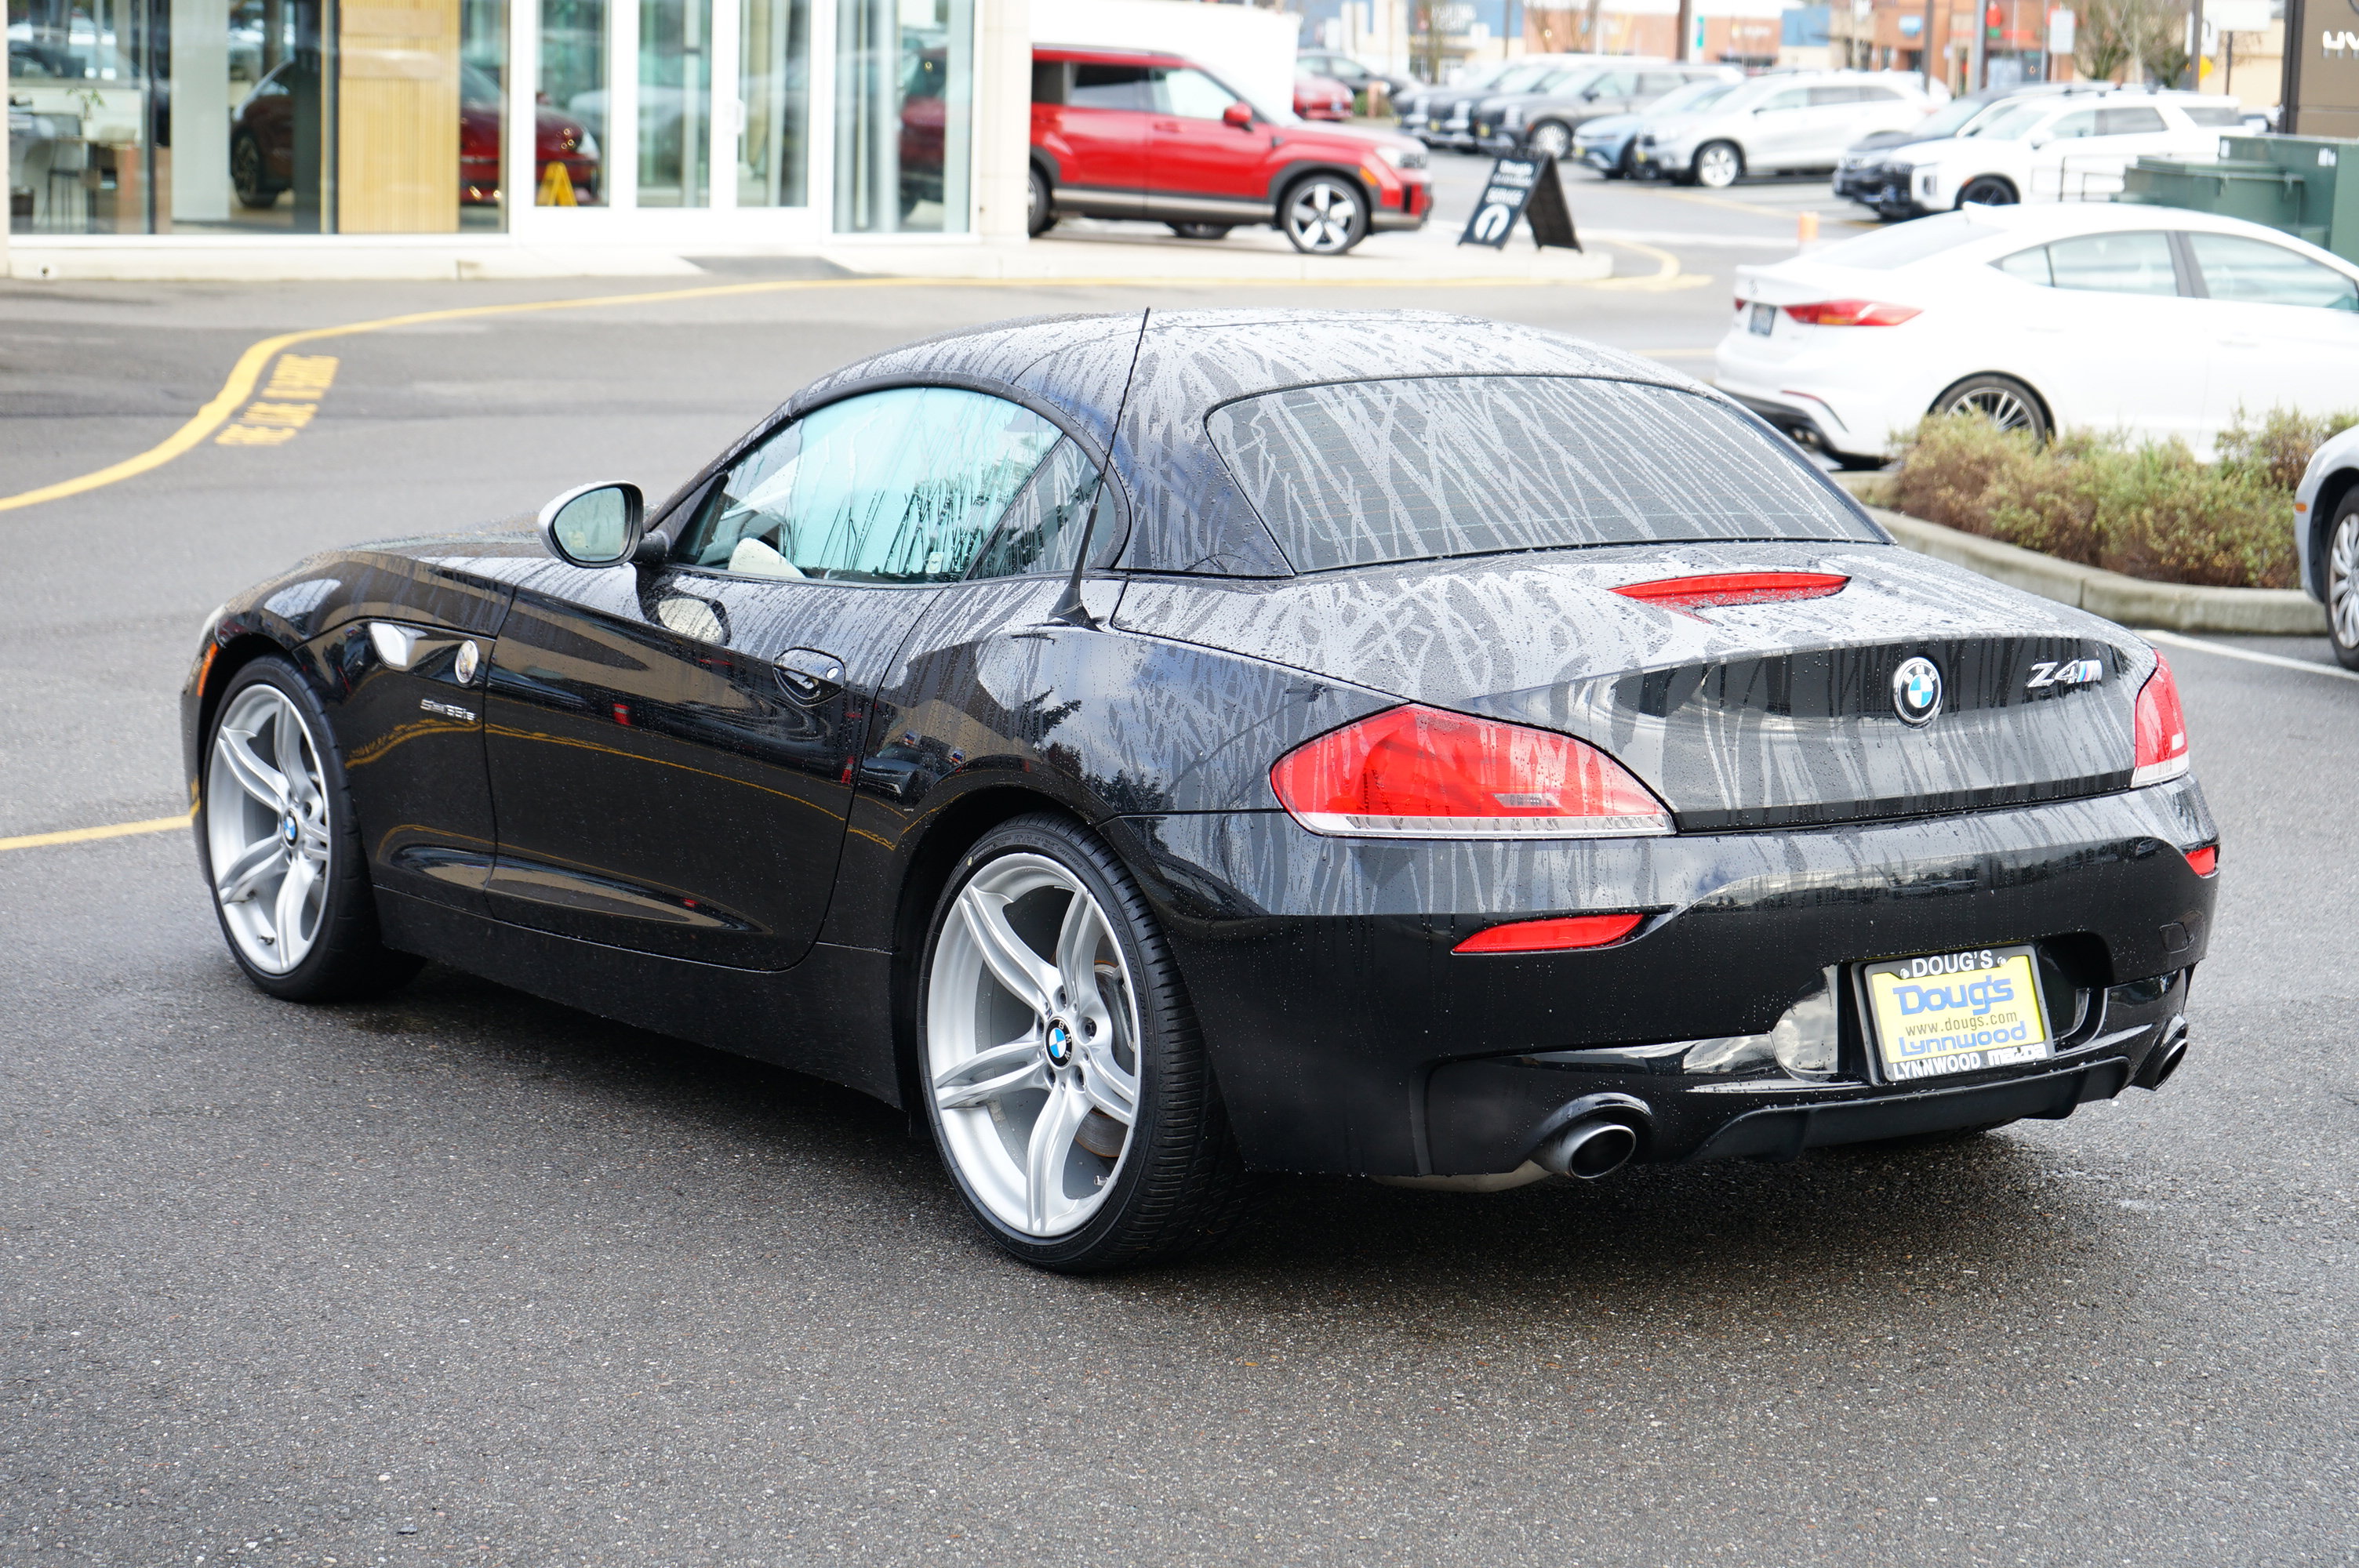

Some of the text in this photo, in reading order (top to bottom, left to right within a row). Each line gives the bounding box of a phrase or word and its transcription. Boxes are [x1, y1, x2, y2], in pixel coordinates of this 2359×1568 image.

[1911, 949, 1994, 978] DOUG'S
[1892, 975, 2015, 1016] Doug's
[1899, 1021, 2027, 1056] Lynnwood
[1905, 1011, 2018, 1036] www.dougs.com
[1058, 1021, 1072, 1060] BMW
[1892, 1053, 1981, 1080] LYNNWOOD
